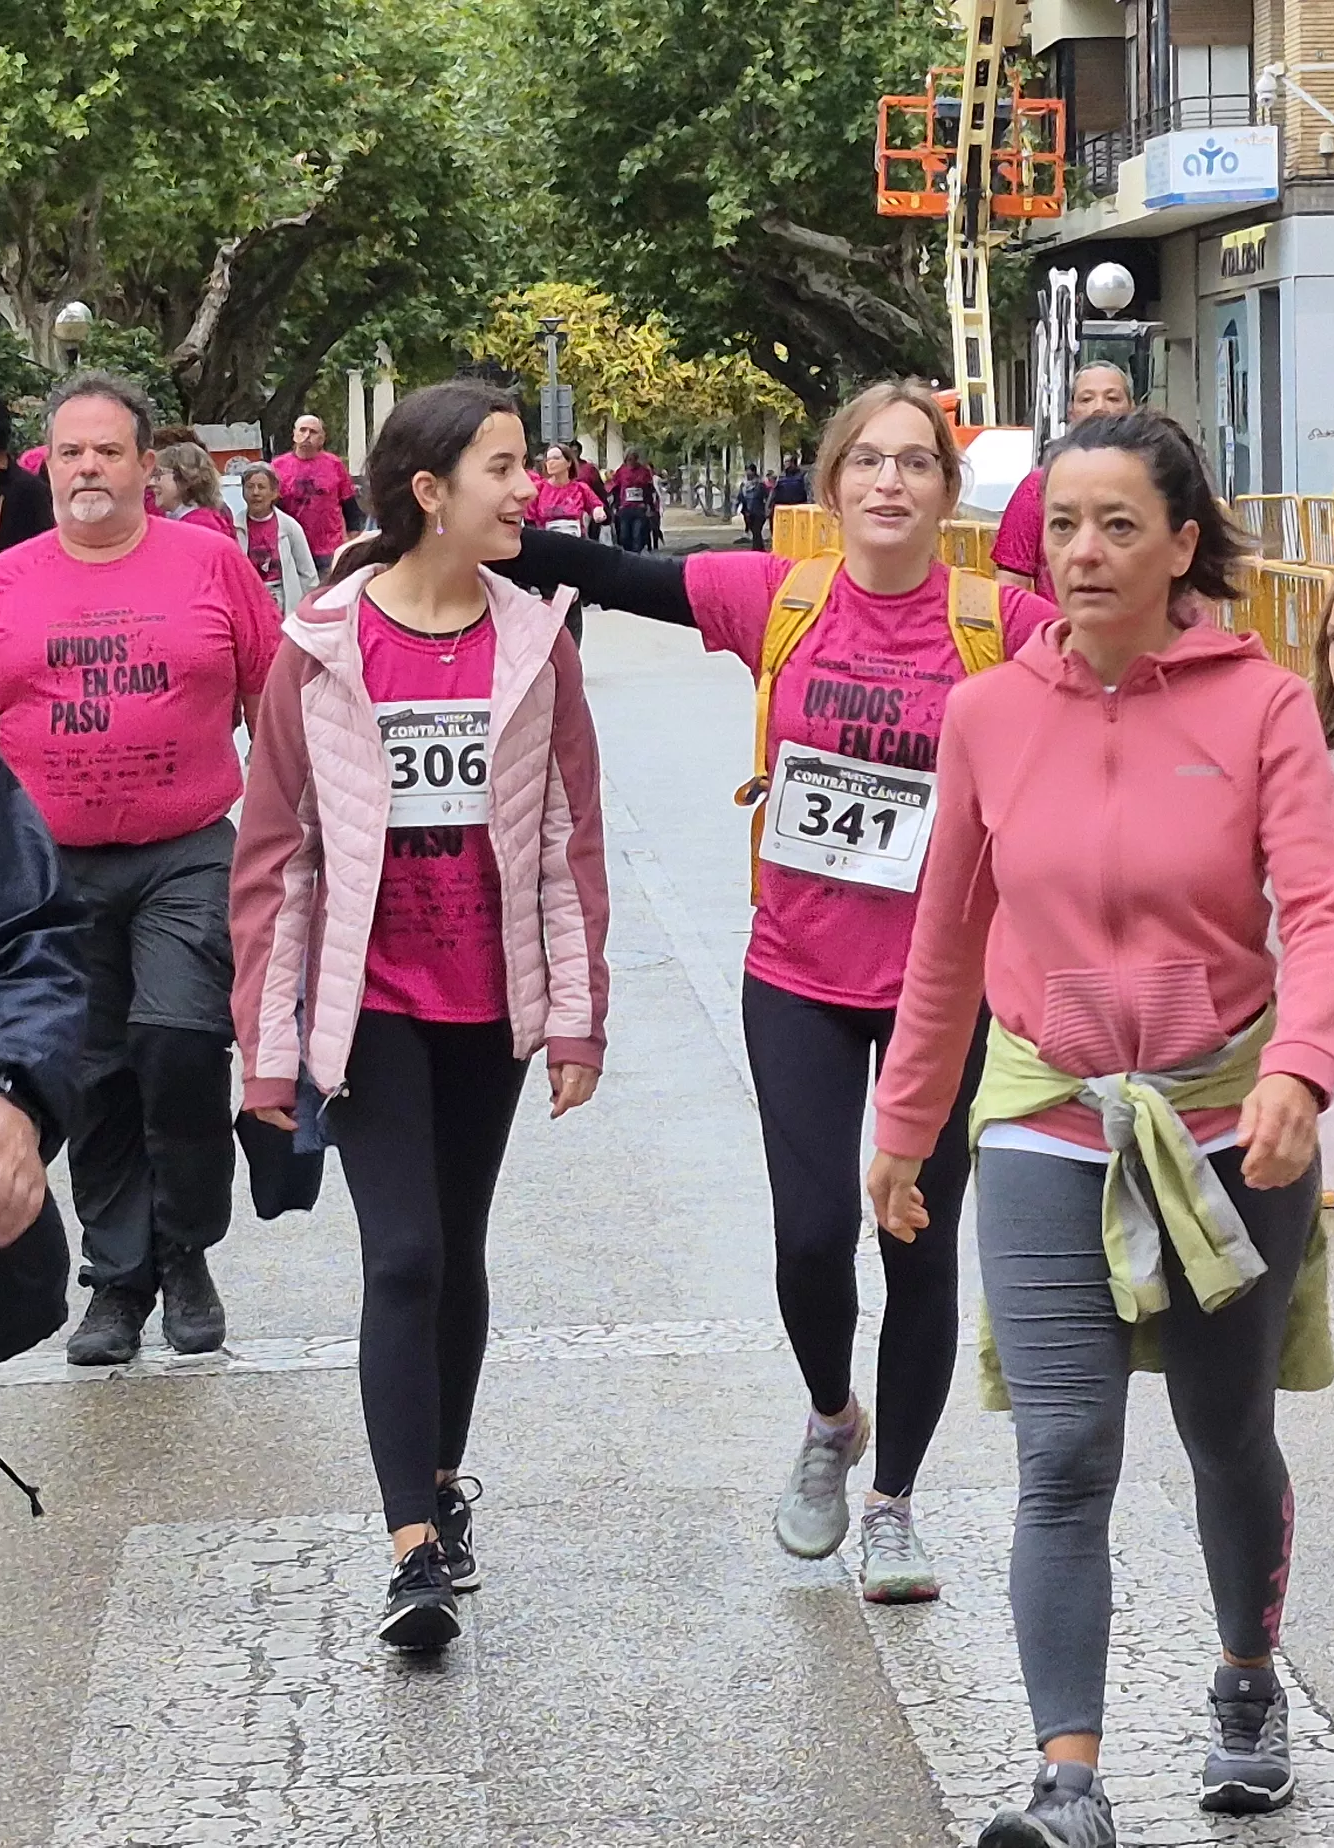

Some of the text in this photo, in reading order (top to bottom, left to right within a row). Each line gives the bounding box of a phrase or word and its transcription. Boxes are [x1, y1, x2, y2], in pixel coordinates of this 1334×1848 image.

[47, 633, 128, 668] UNIDOS
[82, 661, 169, 697] EN CADA
[51, 700, 110, 735] PASO
[803, 678, 904, 726] UNIDOS
[389, 725, 445, 738] CONTRA
[448, 724, 462, 736] EL
[839, 723, 936, 773] EN CAD
[390, 743, 487, 789] 306
[793, 769, 922, 806] CONTRA EL CÁNCER
[798, 792, 898, 850] 341
